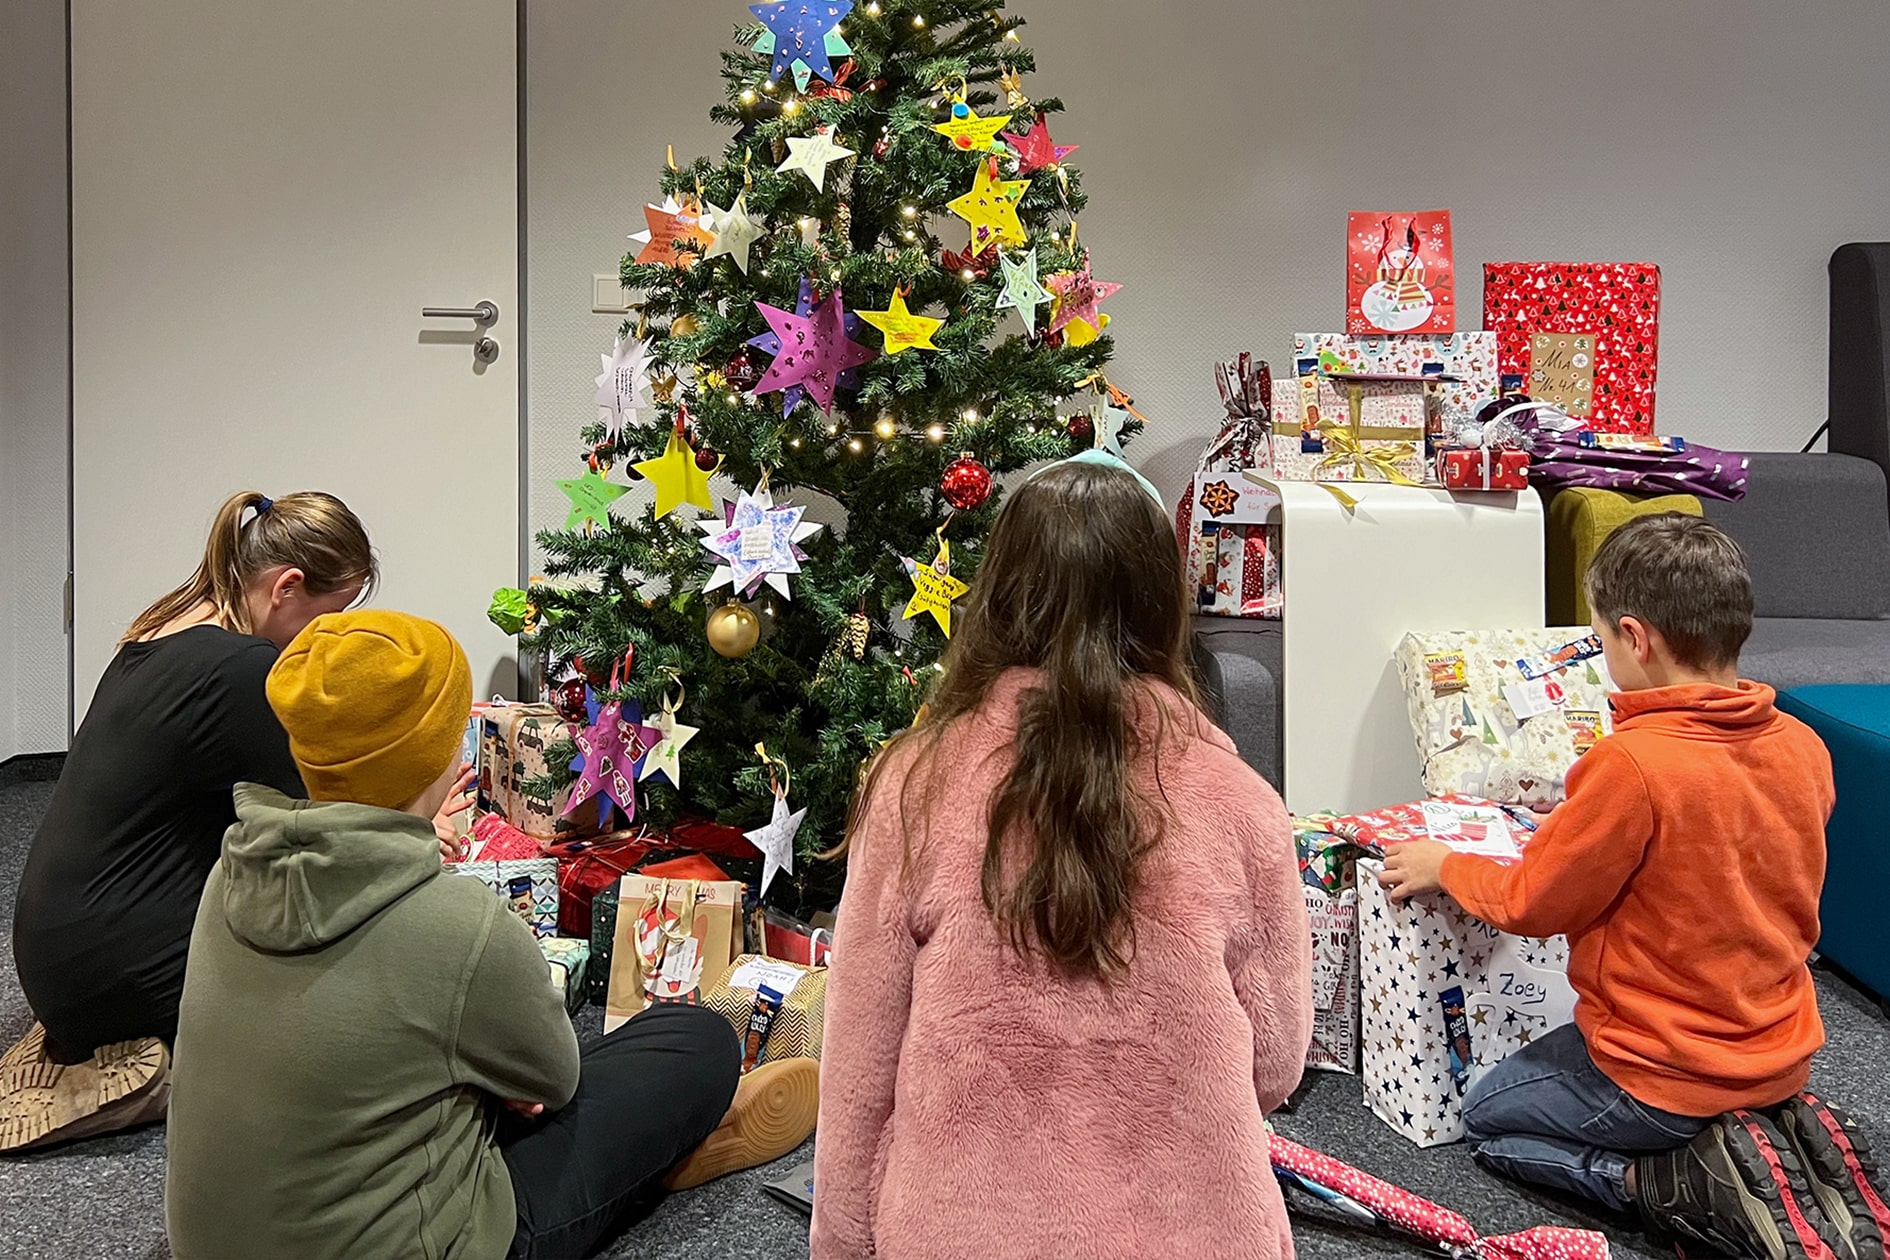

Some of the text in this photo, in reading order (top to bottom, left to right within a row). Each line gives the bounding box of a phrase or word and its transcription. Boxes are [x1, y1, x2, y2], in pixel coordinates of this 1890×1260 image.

[1559, 379, 1576, 394] 41
[1242, 486, 1278, 497] Weihnac
[1428, 654, 1460, 664] HARIBO
[1566, 715, 1596, 723] HARIBO
[645, 883, 682, 897] MERY
[1499, 972, 1547, 1005] Zoey
